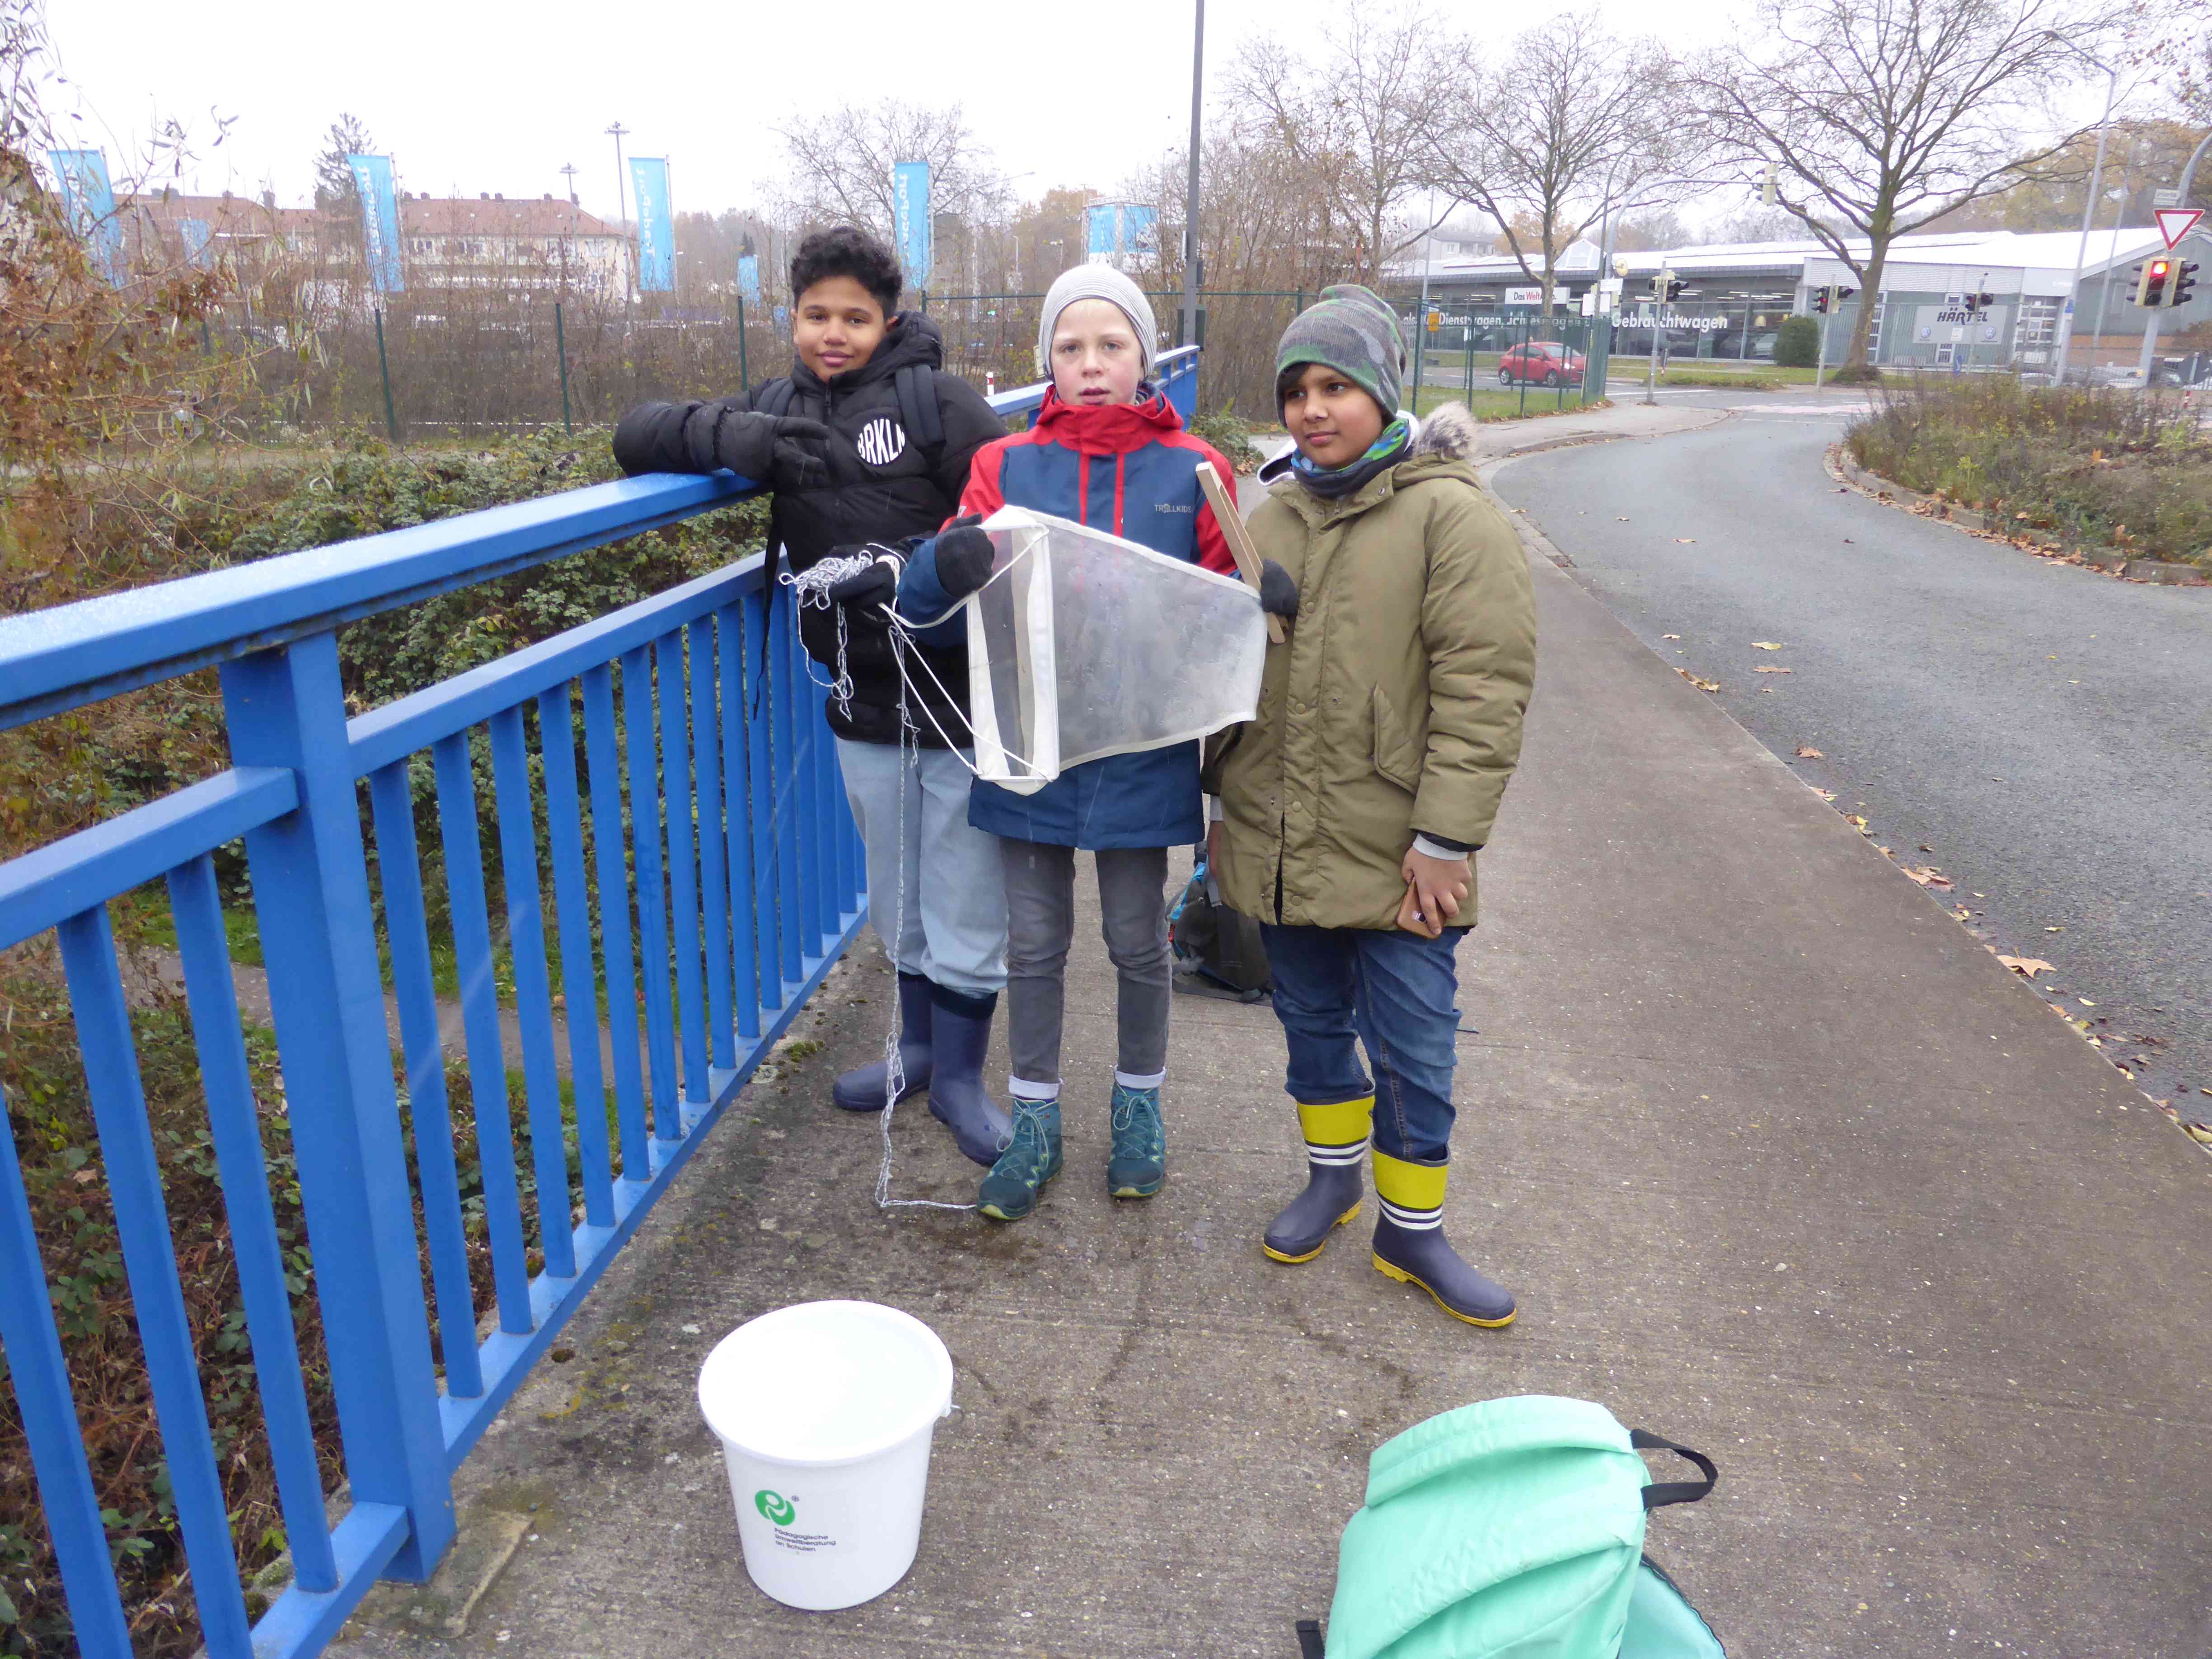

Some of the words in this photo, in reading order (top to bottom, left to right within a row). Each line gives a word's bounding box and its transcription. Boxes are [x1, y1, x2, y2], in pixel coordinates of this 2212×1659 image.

[1514, 291, 1525, 300] Das
[1612, 311, 1728, 333] Gebrauchtwagen
[1937, 307, 1988, 326] HÄRTEL
[858, 418, 905, 465] BRKLN
